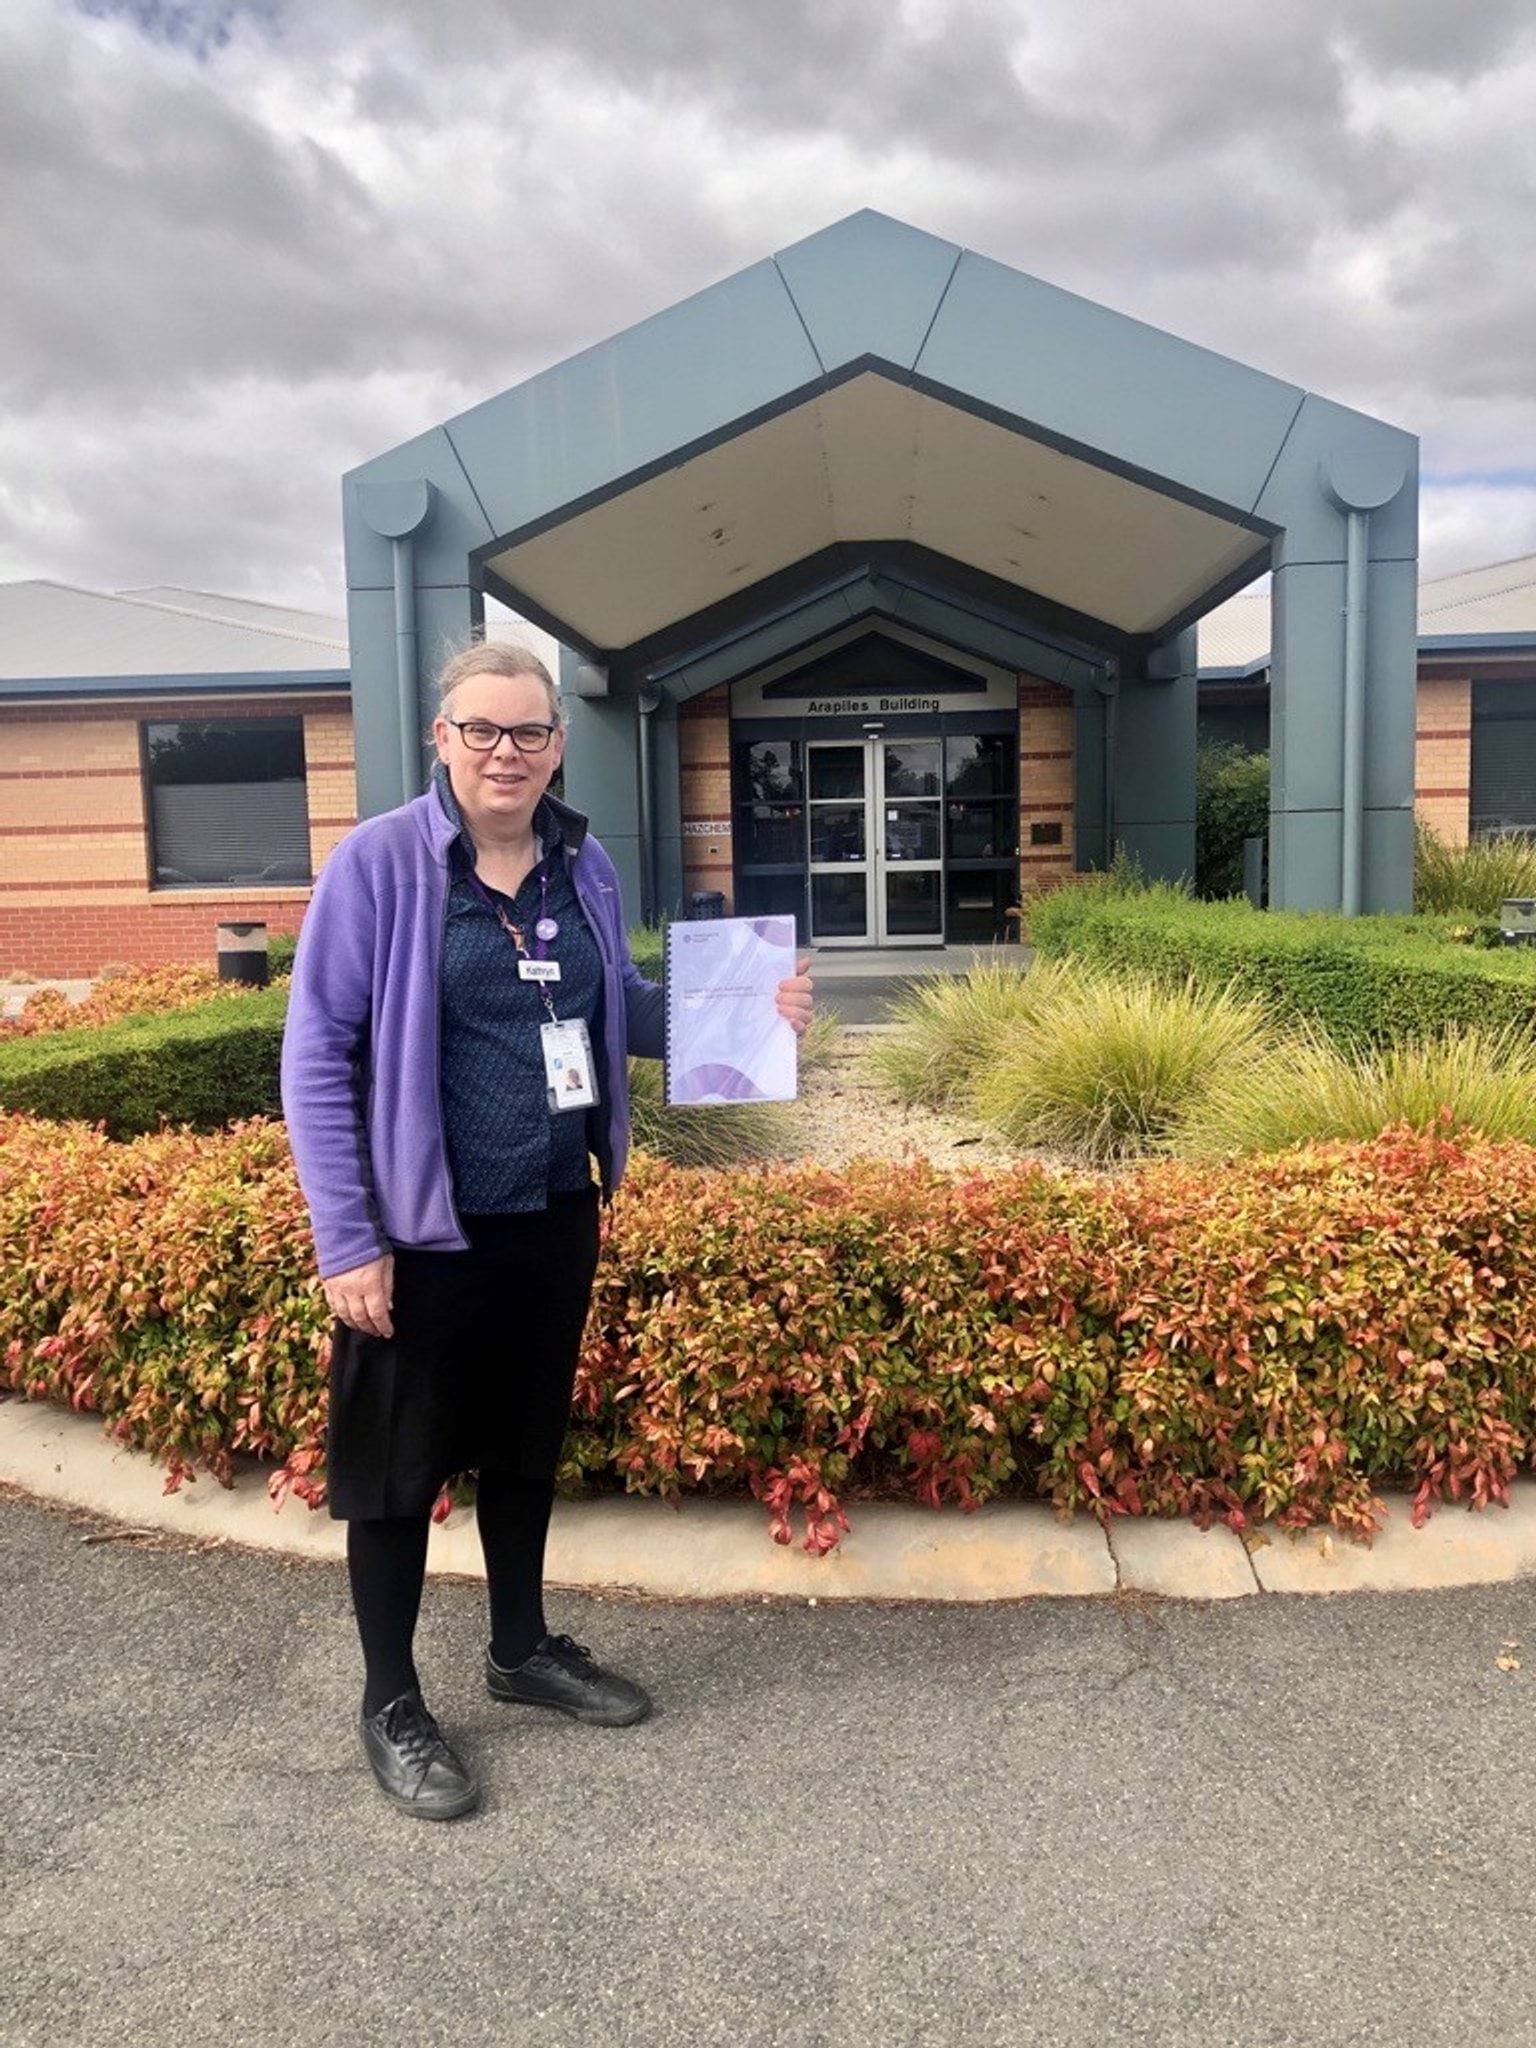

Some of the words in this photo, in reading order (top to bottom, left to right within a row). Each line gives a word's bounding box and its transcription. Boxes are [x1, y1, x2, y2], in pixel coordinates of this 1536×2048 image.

[807, 700, 869, 715] Arapiles
[879, 698, 940, 713] Building
[525, 966, 555, 977] Kathryn
